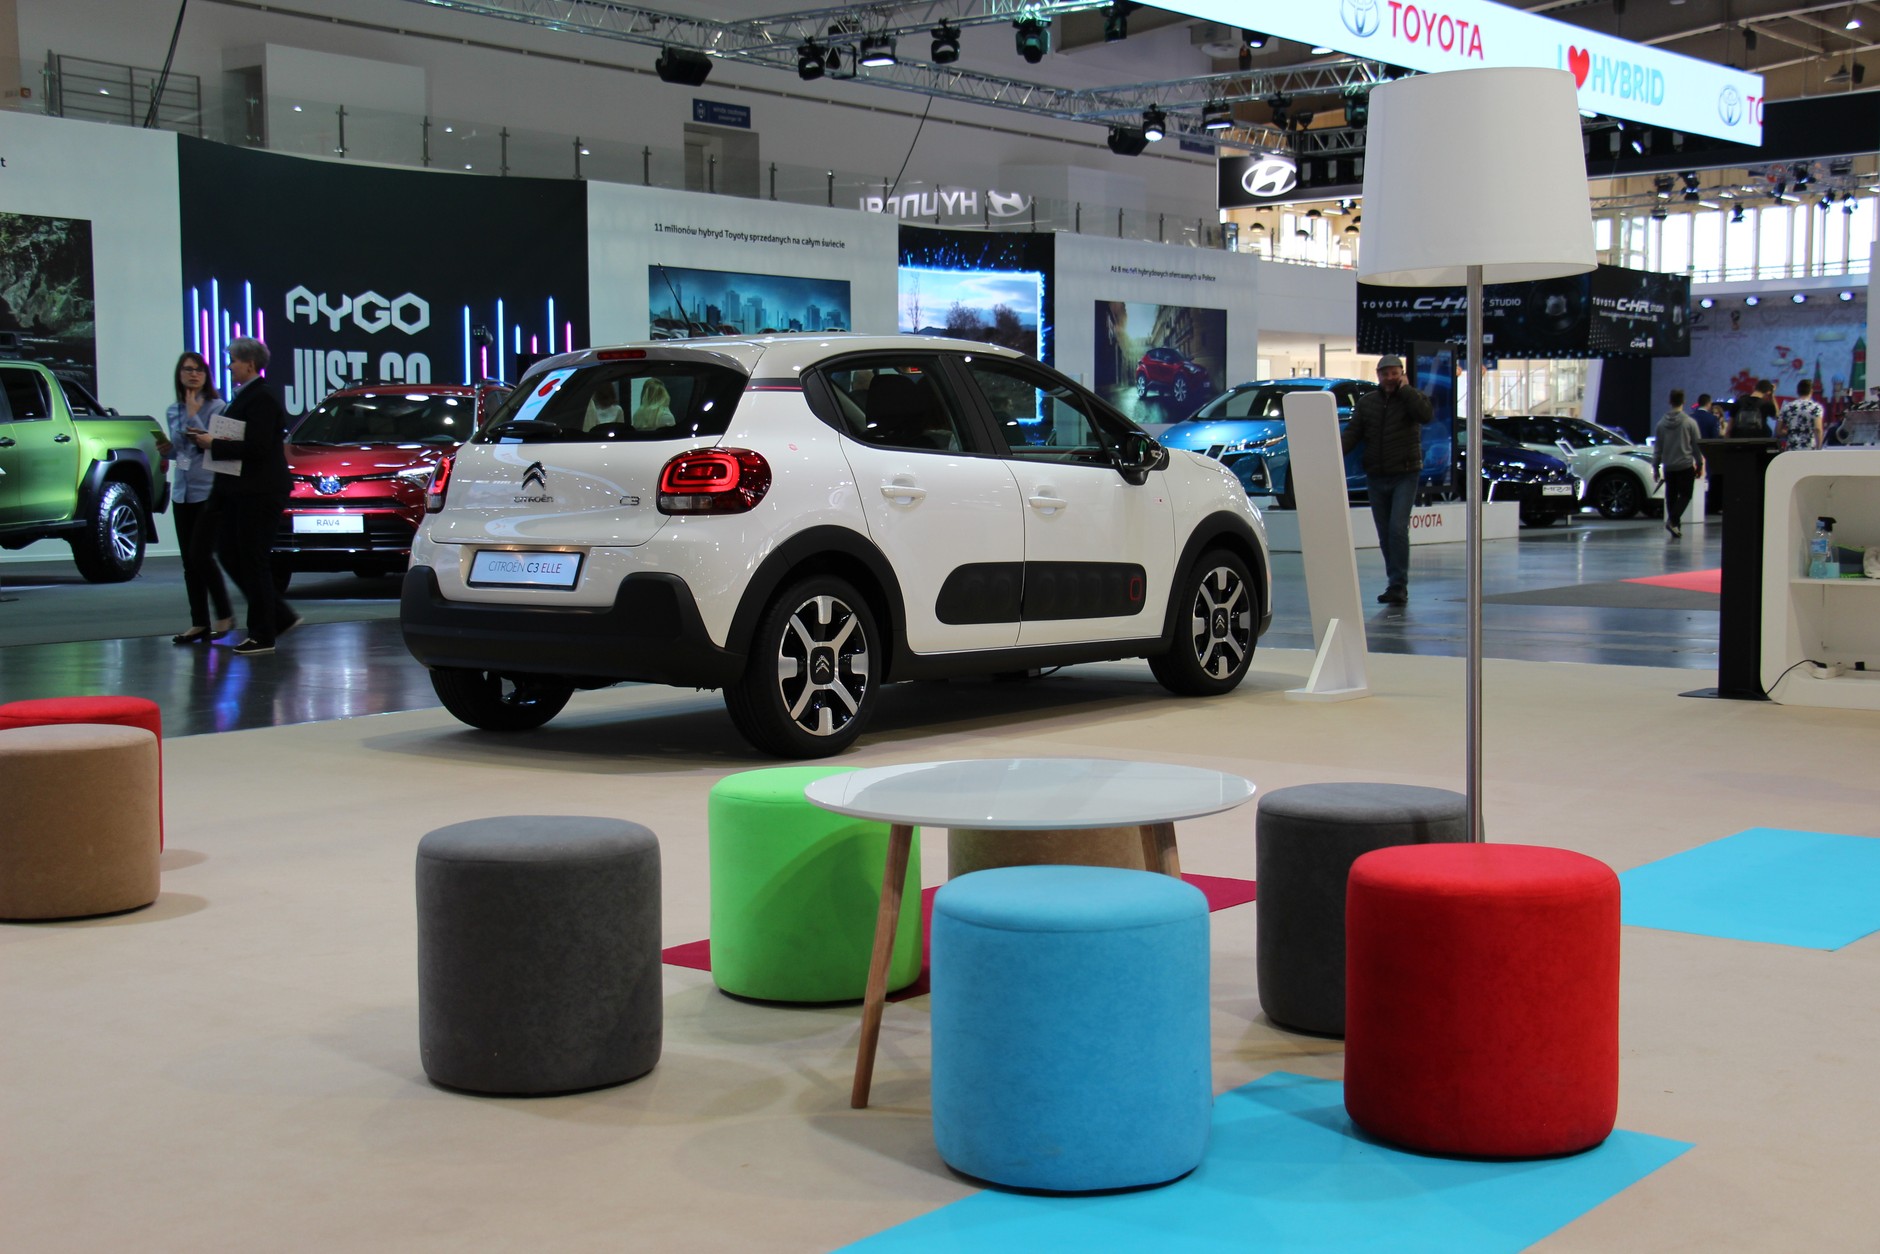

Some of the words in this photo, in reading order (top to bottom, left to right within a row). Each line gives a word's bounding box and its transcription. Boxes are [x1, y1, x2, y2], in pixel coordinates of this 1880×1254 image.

[1388, 0, 1484, 61] TOYOTA
[1591, 53, 1665, 106] HYBRID
[654, 223, 663, 232] 11
[664, 224, 697, 236] milionów
[698, 227, 724, 239] hybryd
[724, 229, 749, 242] Toyoty
[749, 233, 792, 246] sprzedanych
[792, 237, 800, 245] na
[821, 238, 846, 249] świecie
[285, 284, 431, 336] AYGO
[1362, 300, 1408, 309] TOYOTA
[1413, 297, 1485, 310] C-H
[1489, 298, 1521, 307] STUDIO
[1592, 297, 1616, 307] TOYOTA
[1616, 298, 1650, 313] C-HR
[284, 348, 368, 416] JUST
[619, 495, 640, 506] C3
[316, 519, 340, 527] RAV4
[488, 560, 525, 573] CITROËN
[526, 562, 540, 573] C3
[540, 562, 562, 574] ELLE
